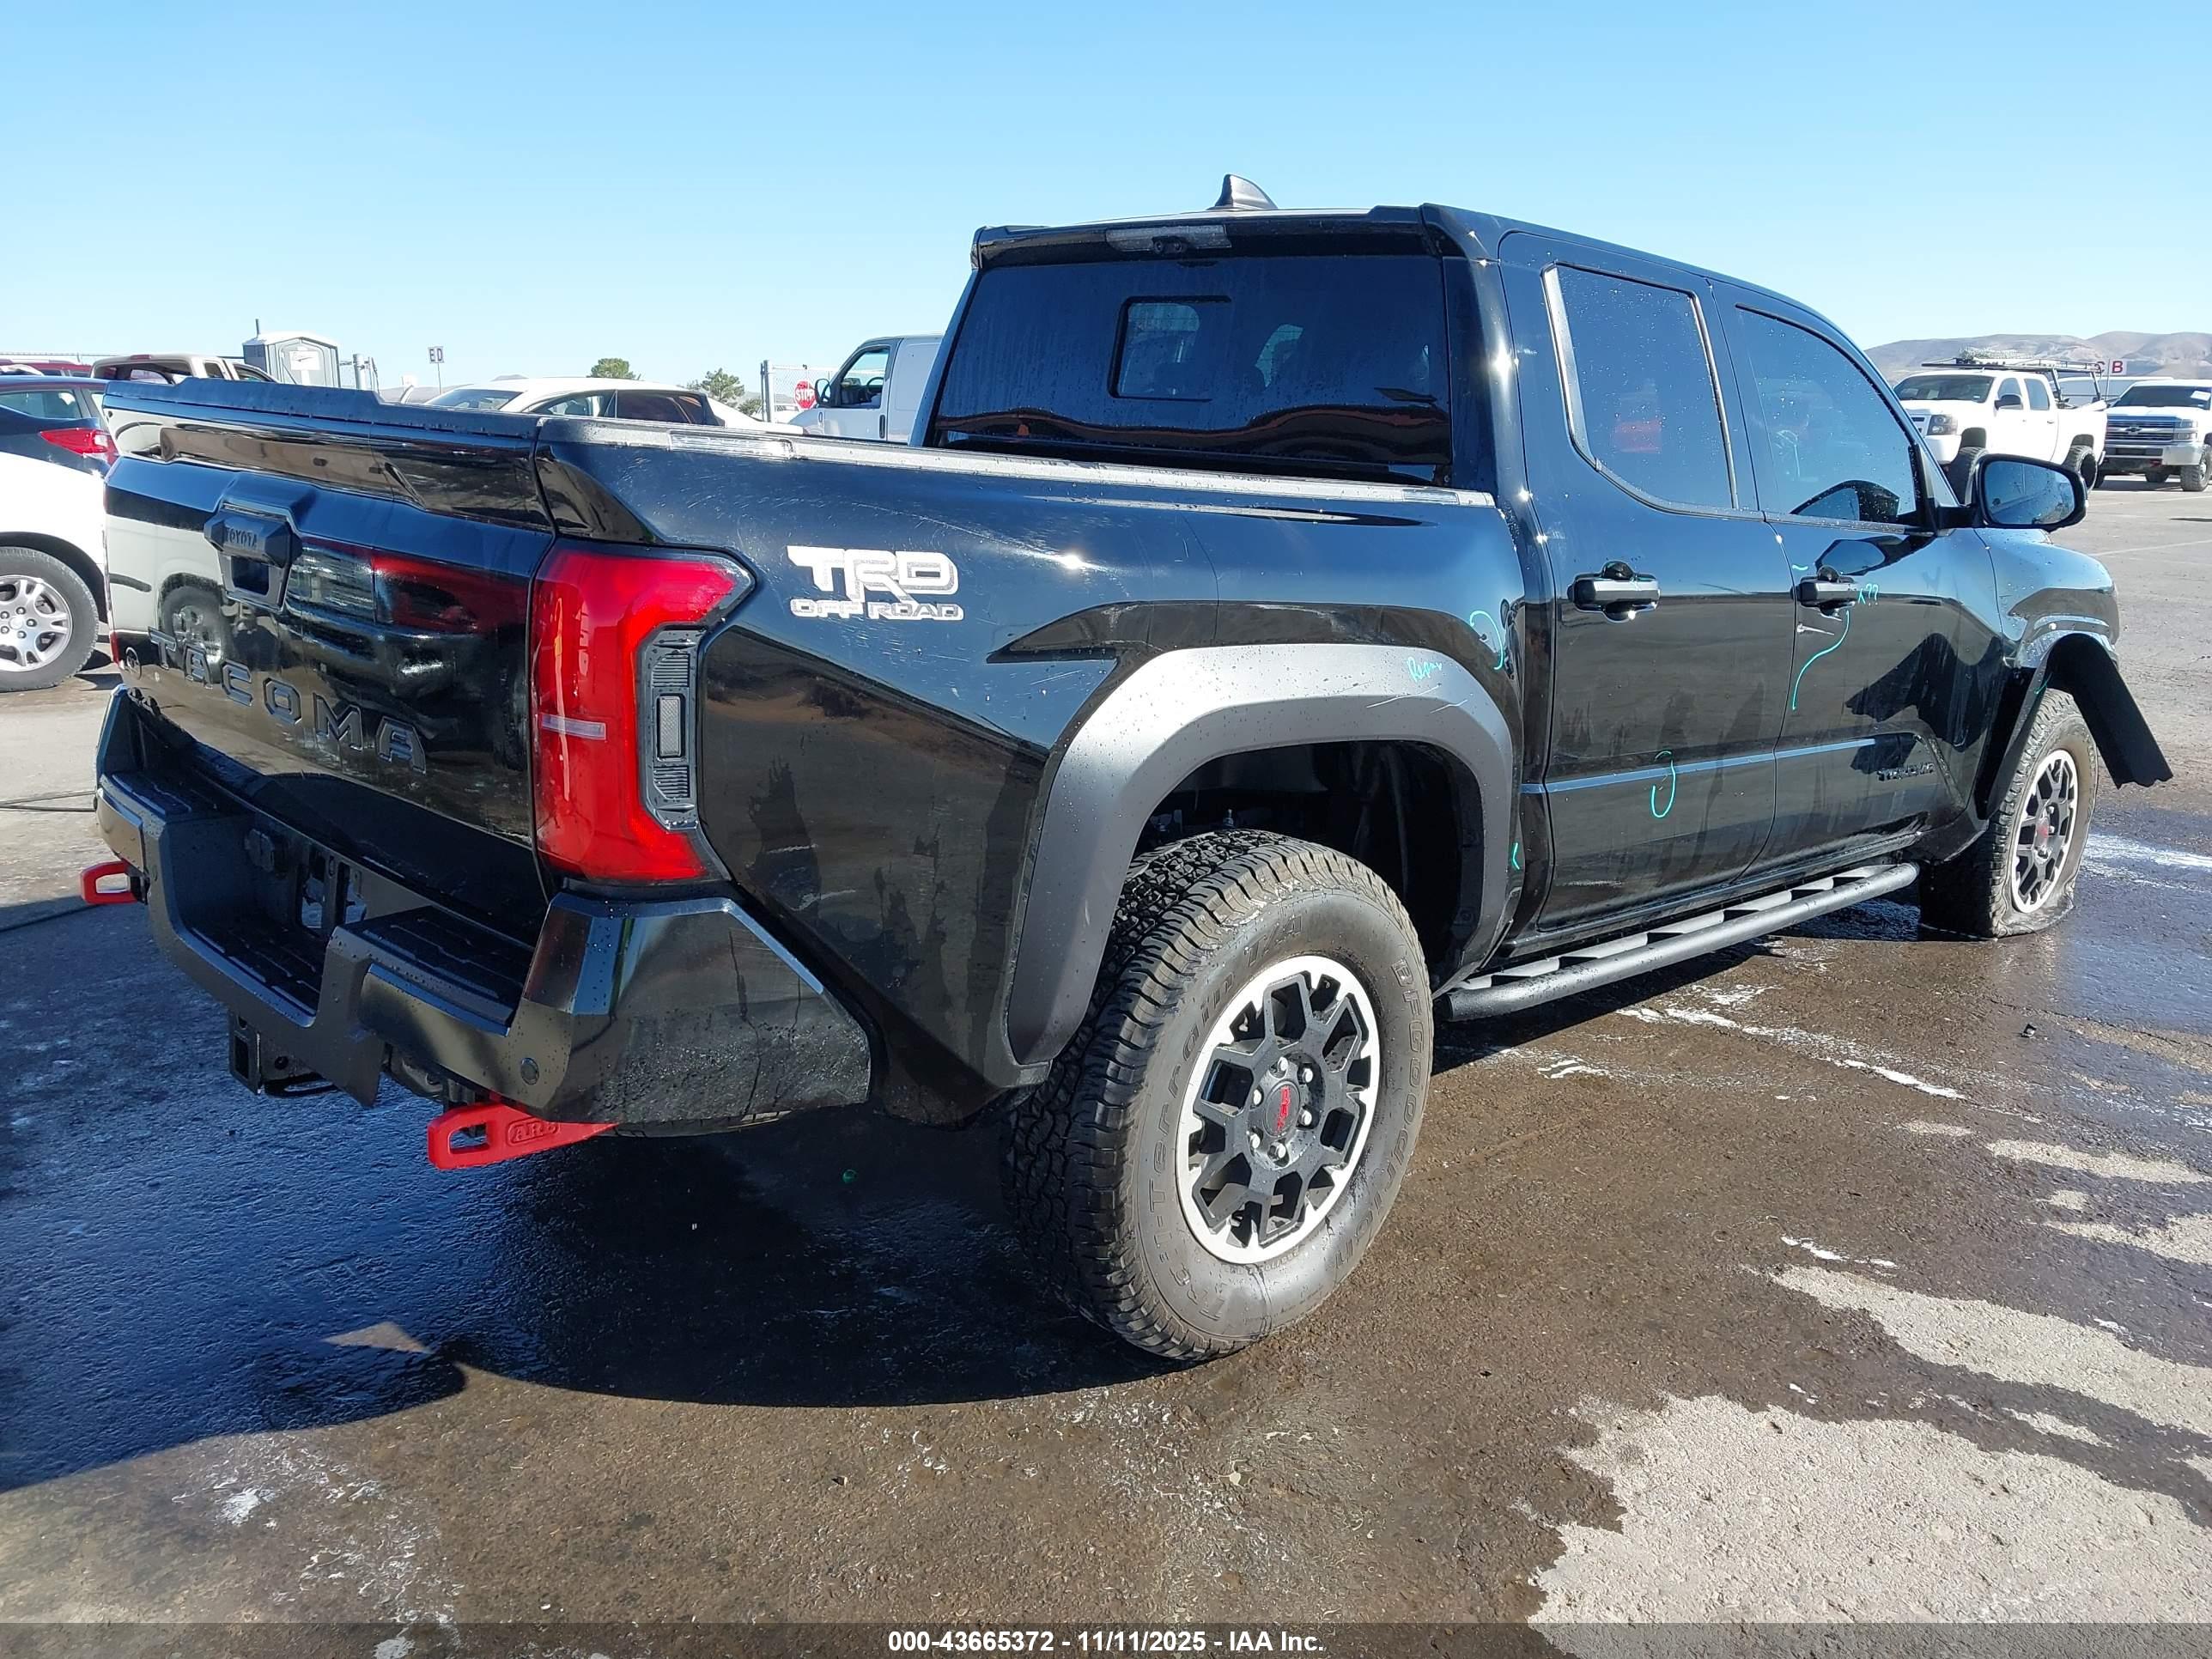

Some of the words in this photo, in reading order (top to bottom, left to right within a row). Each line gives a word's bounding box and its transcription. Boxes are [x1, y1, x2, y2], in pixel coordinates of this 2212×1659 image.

[2112, 360, 2124, 374] B
[795, 388, 817, 402] STOP
[226, 528, 258, 548] TOYOTA
[787, 545, 958, 603] TRD
[790, 599, 864, 618] OFF
[866, 600, 964, 621] ROAD
[148, 625, 427, 775] TACOMA
[1331, 957, 1426, 1274] BFGoodrich
